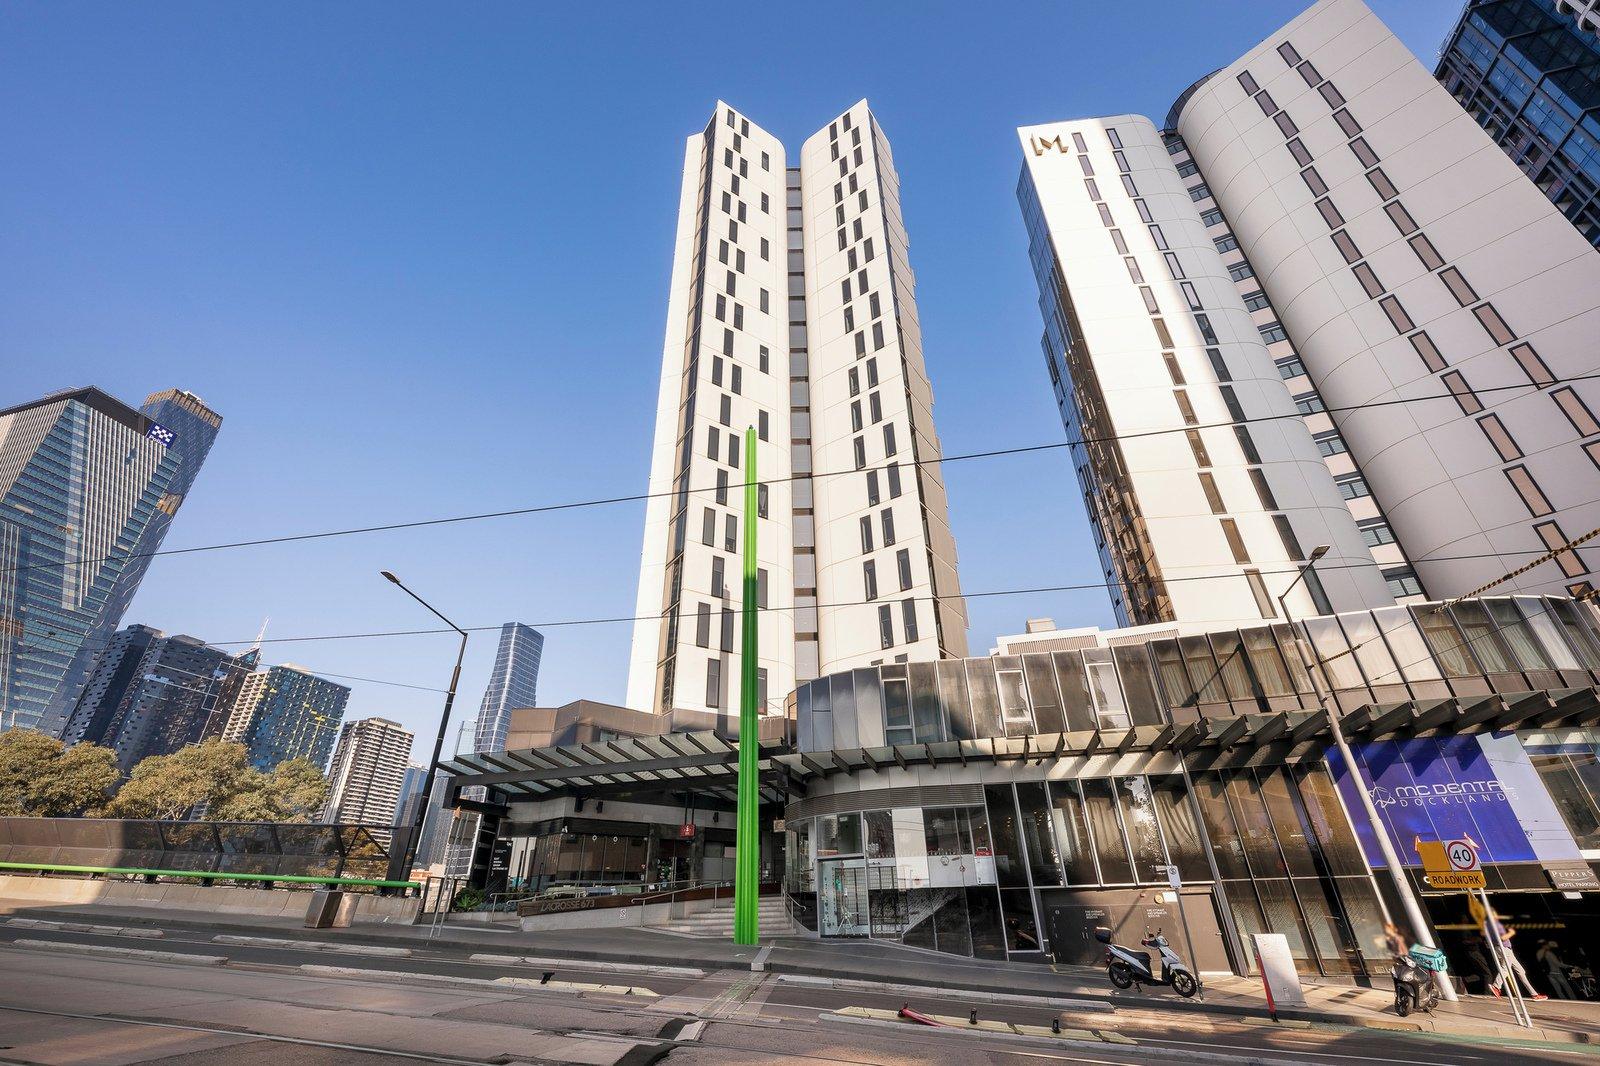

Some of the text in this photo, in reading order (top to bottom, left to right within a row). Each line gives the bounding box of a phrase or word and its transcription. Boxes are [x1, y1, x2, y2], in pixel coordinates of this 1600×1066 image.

[1433, 780, 1514, 795] DENTAL
[1399, 793, 1519, 808] DOCKLANDS
[1453, 849, 1471, 861] 40
[1551, 869, 1594, 878] PEPPERS
[1432, 875, 1482, 885] ROADWORK
[540, 899, 595, 912] LACROSSE 673
